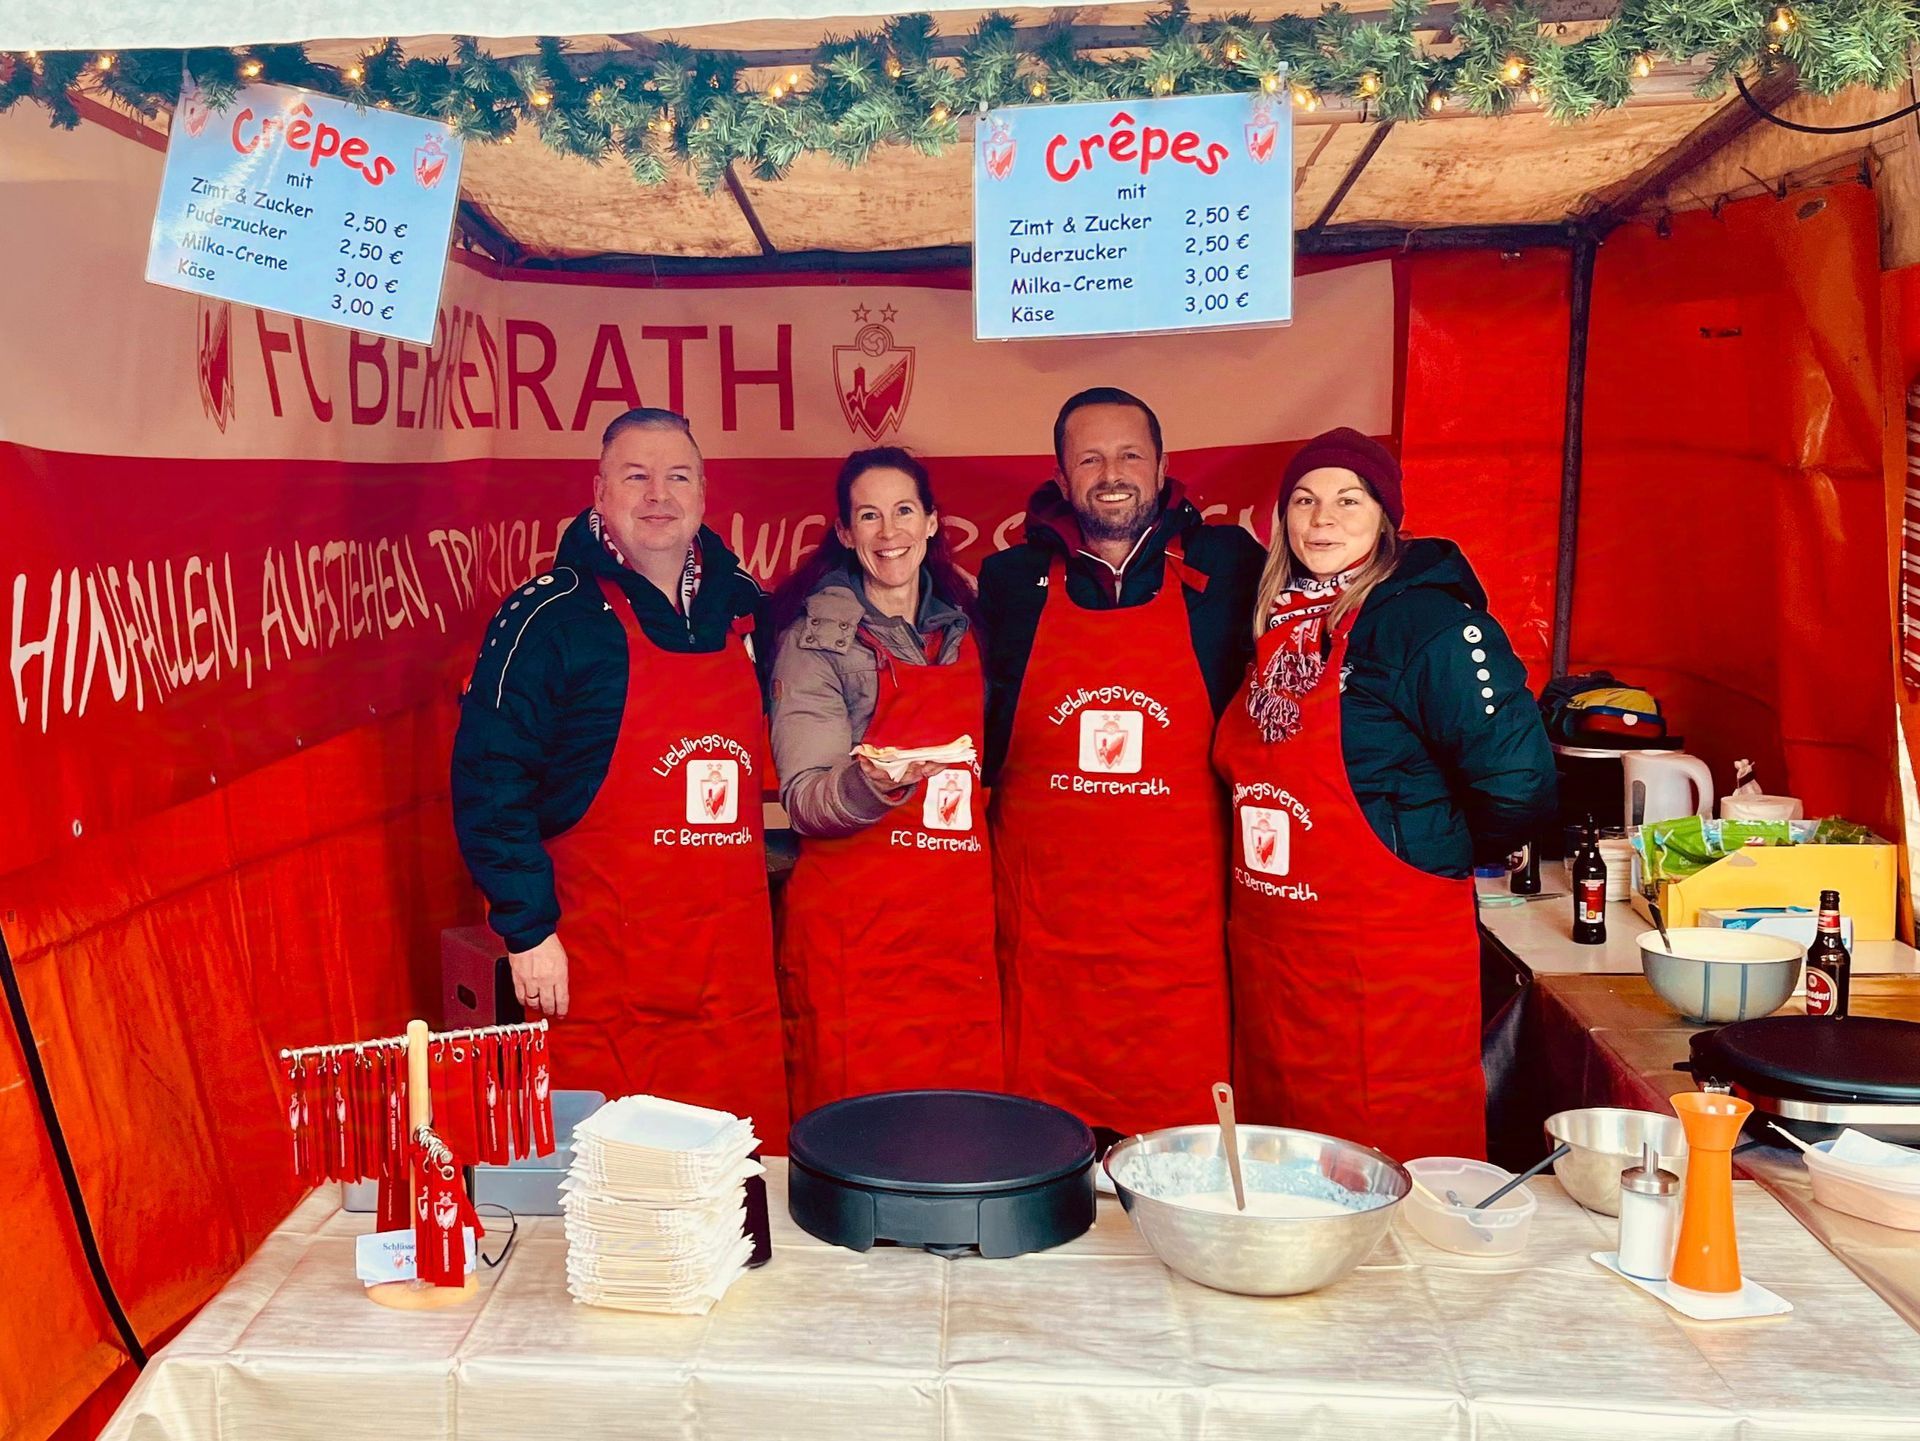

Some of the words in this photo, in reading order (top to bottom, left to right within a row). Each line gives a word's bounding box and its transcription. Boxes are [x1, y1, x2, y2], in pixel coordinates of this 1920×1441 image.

[231, 102, 396, 186] Crêpes
[1045, 111, 1230, 183] Crêpes
[286, 172, 313, 189] mit
[1117, 183, 1147, 200] mit
[190, 176, 228, 199] Zimt
[234, 188, 247, 204] &
[253, 191, 313, 219] Zucker
[343, 212, 387, 234] 2,50
[394, 223, 408, 238] €
[1009, 218, 1054, 236] Zimt
[1063, 217, 1076, 233] &
[1085, 213, 1152, 232] Zucker
[1185, 206, 1230, 228] 2,50
[1237, 205, 1250, 221] €
[187, 203, 287, 240] Puderzucker
[340, 239, 383, 261] 2,50
[389, 250, 403, 265] €
[1010, 243, 1127, 264] Puderzucker
[1185, 235, 1230, 256] 2,50
[1236, 233, 1249, 250] €
[182, 232, 288, 271] Milka-Creme
[335, 267, 378, 290] 3,00
[385, 279, 398, 294] €
[177, 258, 215, 281] Käse
[331, 295, 374, 316] 3,00
[380, 306, 394, 320] €
[1011, 276, 1134, 295] Milka-Creme
[1185, 265, 1229, 287] 3,00
[1236, 264, 1249, 280] €
[1012, 306, 1055, 323] Käse
[1184, 293, 1229, 314] 3,00
[1236, 292, 1249, 308] €
[1048, 685, 1171, 729] Lieblingsverein
[652, 734, 752, 777] Lieblingsverein
[1050, 774, 1069, 790] FC
[1073, 775, 1170, 795] Berrenrath
[654, 829, 676, 845] FC
[680, 826, 752, 846] Berrenrath
[890, 830, 912, 846] FC
[916, 832, 982, 852] Berrenrath
